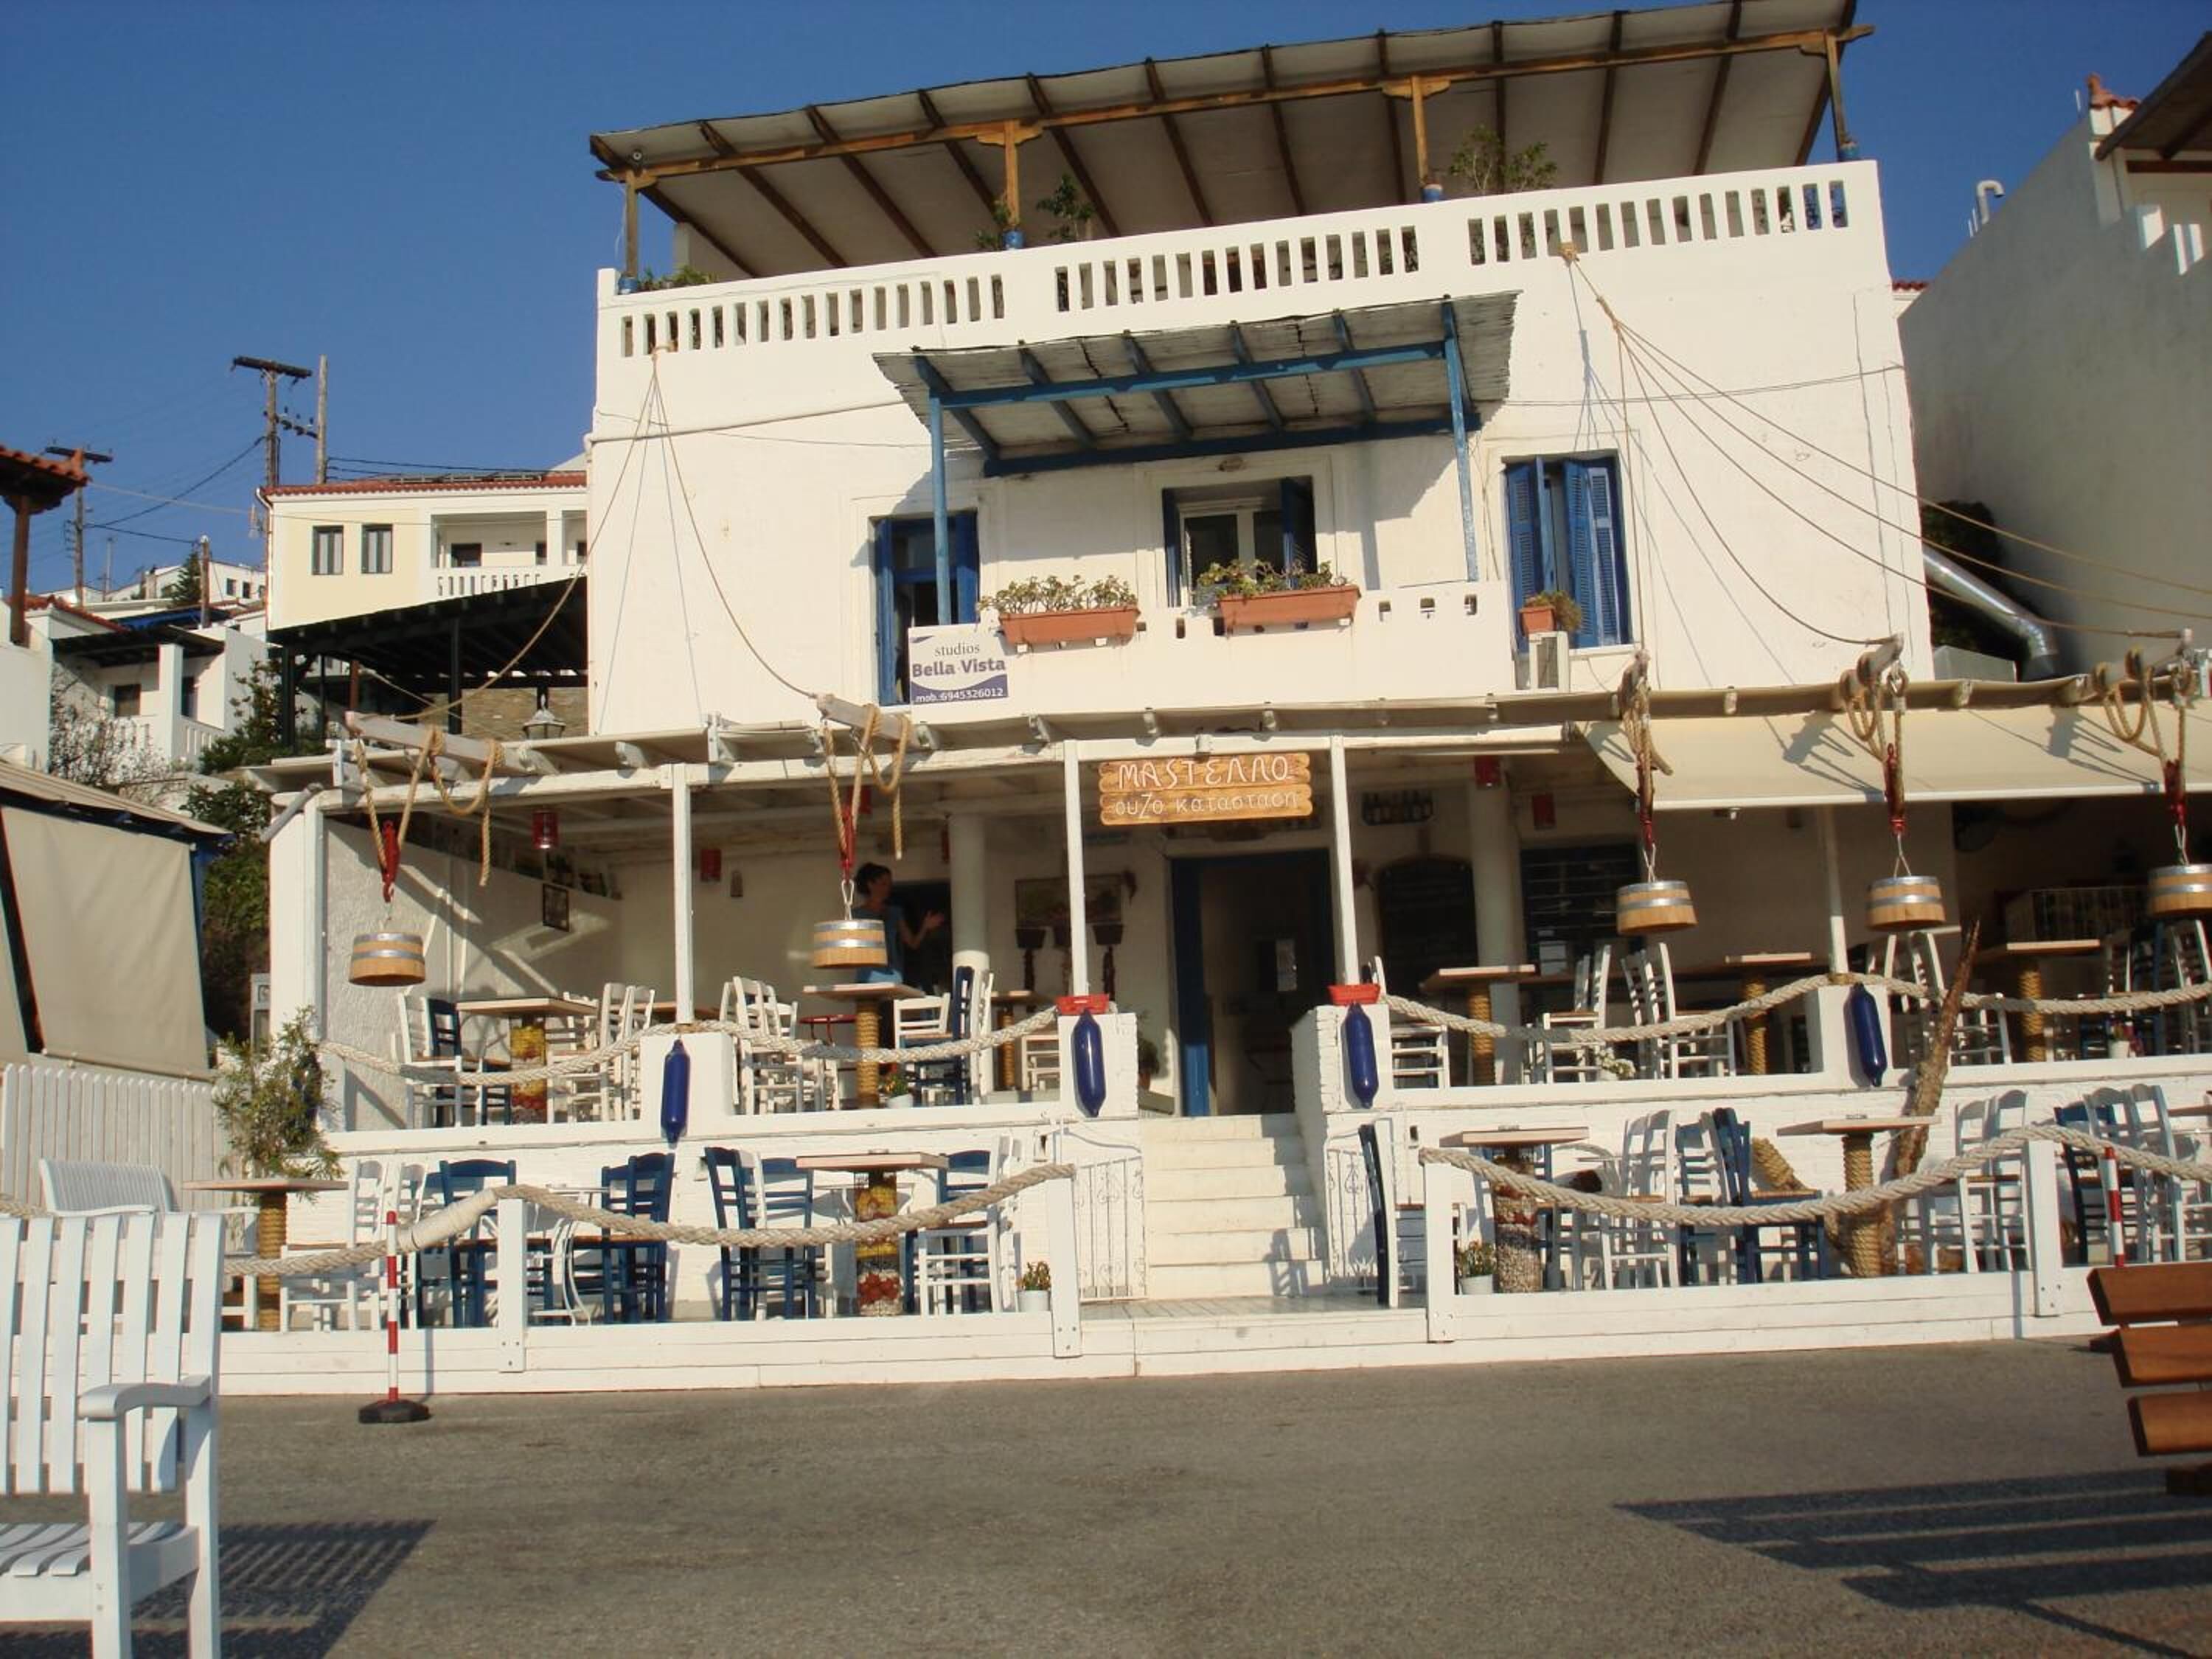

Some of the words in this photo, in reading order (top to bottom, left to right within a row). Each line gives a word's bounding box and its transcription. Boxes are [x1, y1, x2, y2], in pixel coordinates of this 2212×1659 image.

[934, 642, 980, 656] studios
[912, 661, 956, 678] Bella
[961, 658, 1006, 674] Vista
